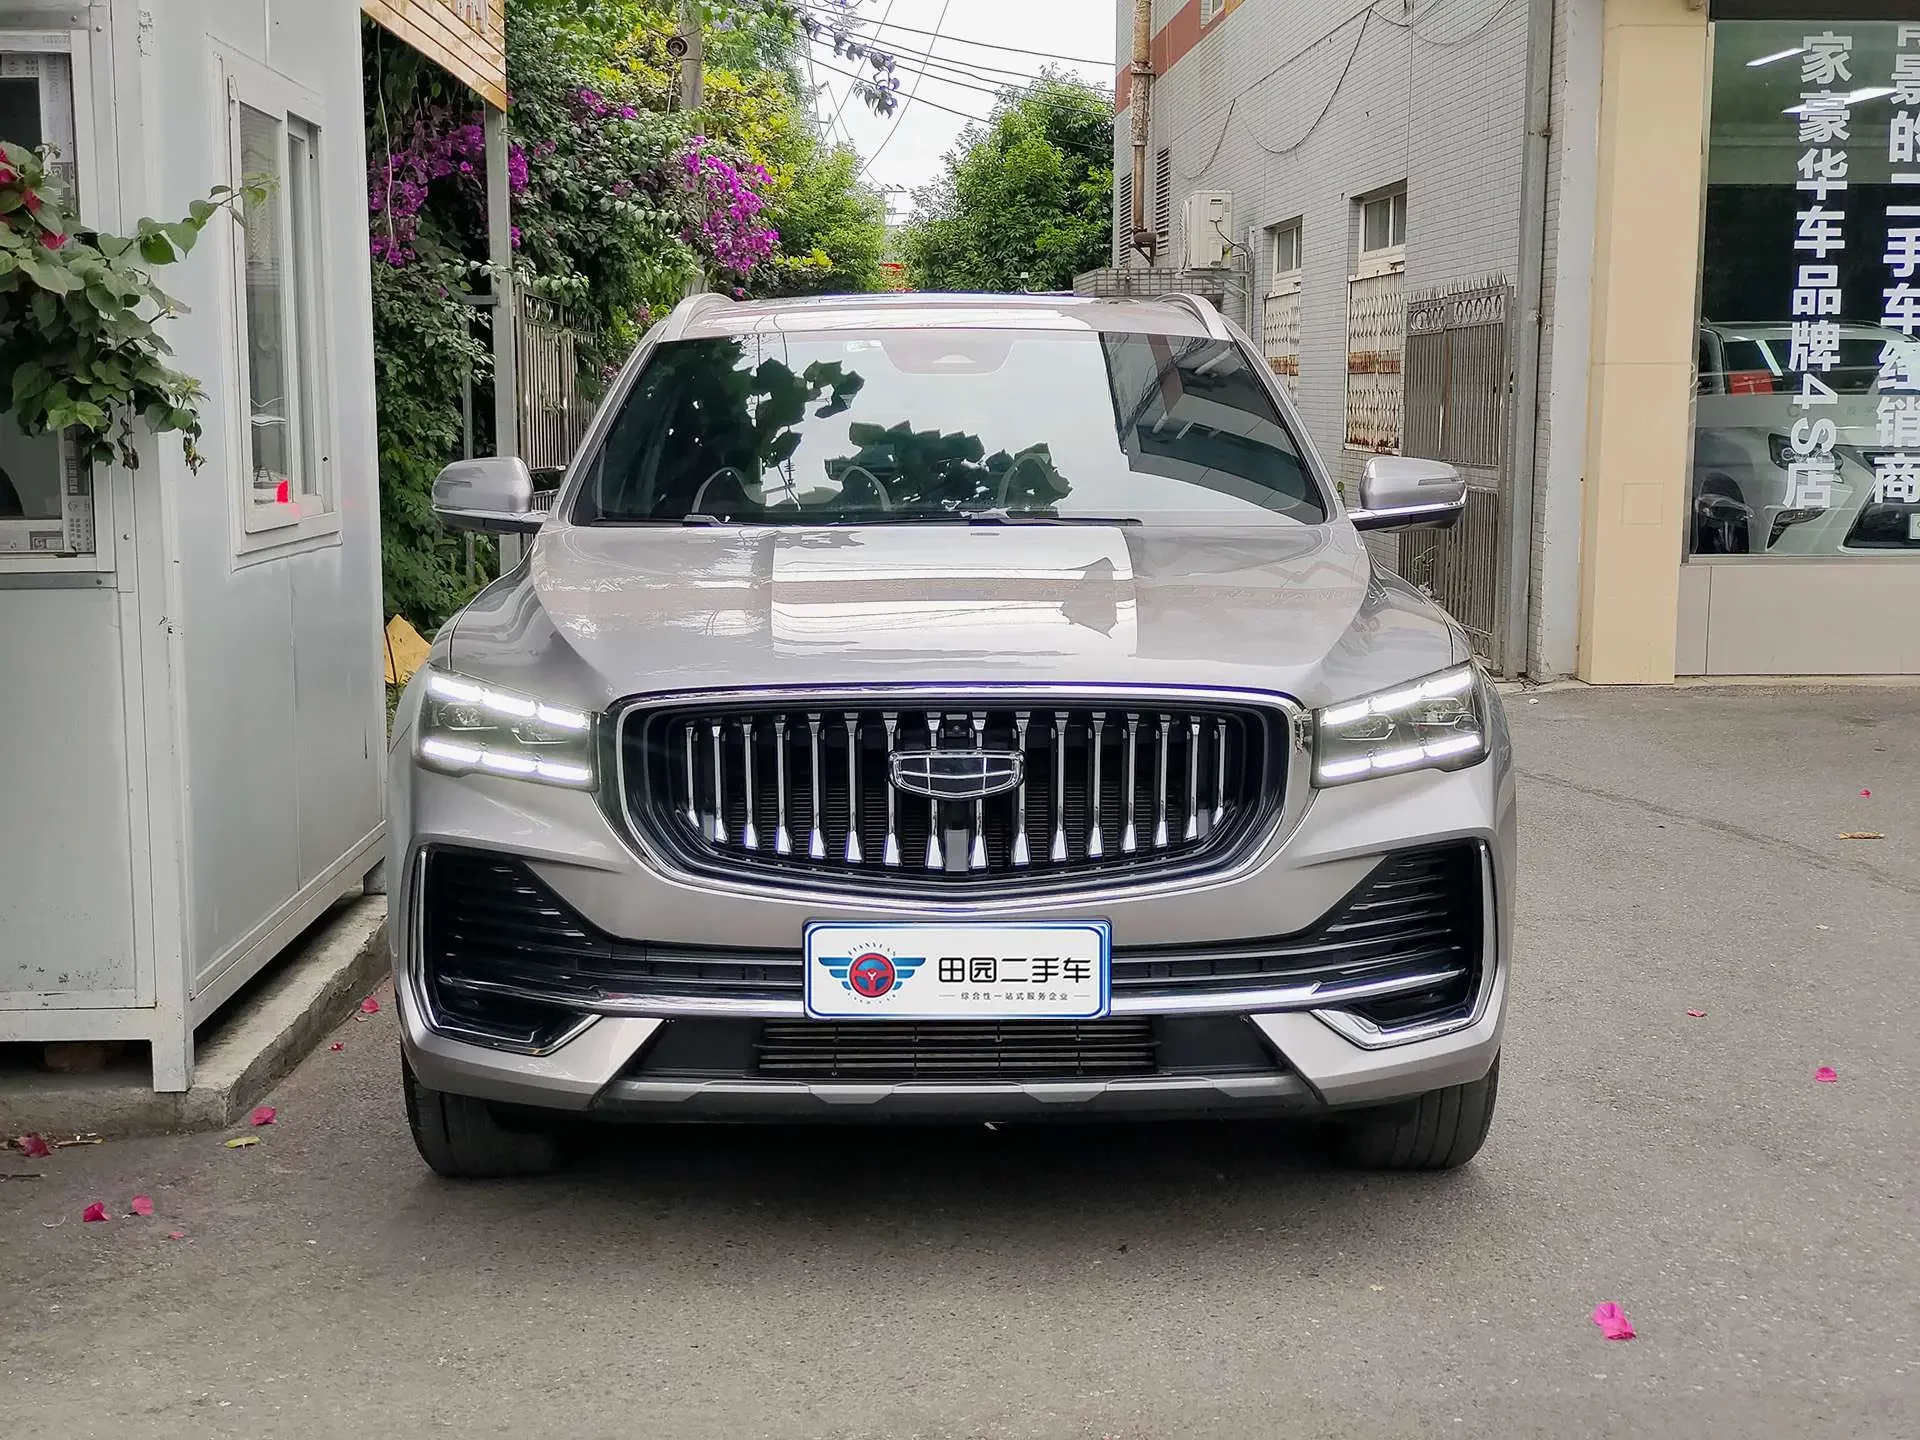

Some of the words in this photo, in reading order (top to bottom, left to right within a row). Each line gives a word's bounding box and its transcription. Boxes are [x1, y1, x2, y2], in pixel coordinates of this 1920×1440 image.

[1783, 31, 1853, 509] 家豪华车品牌4S店
[938, 957, 1091, 983] 田园二手车
